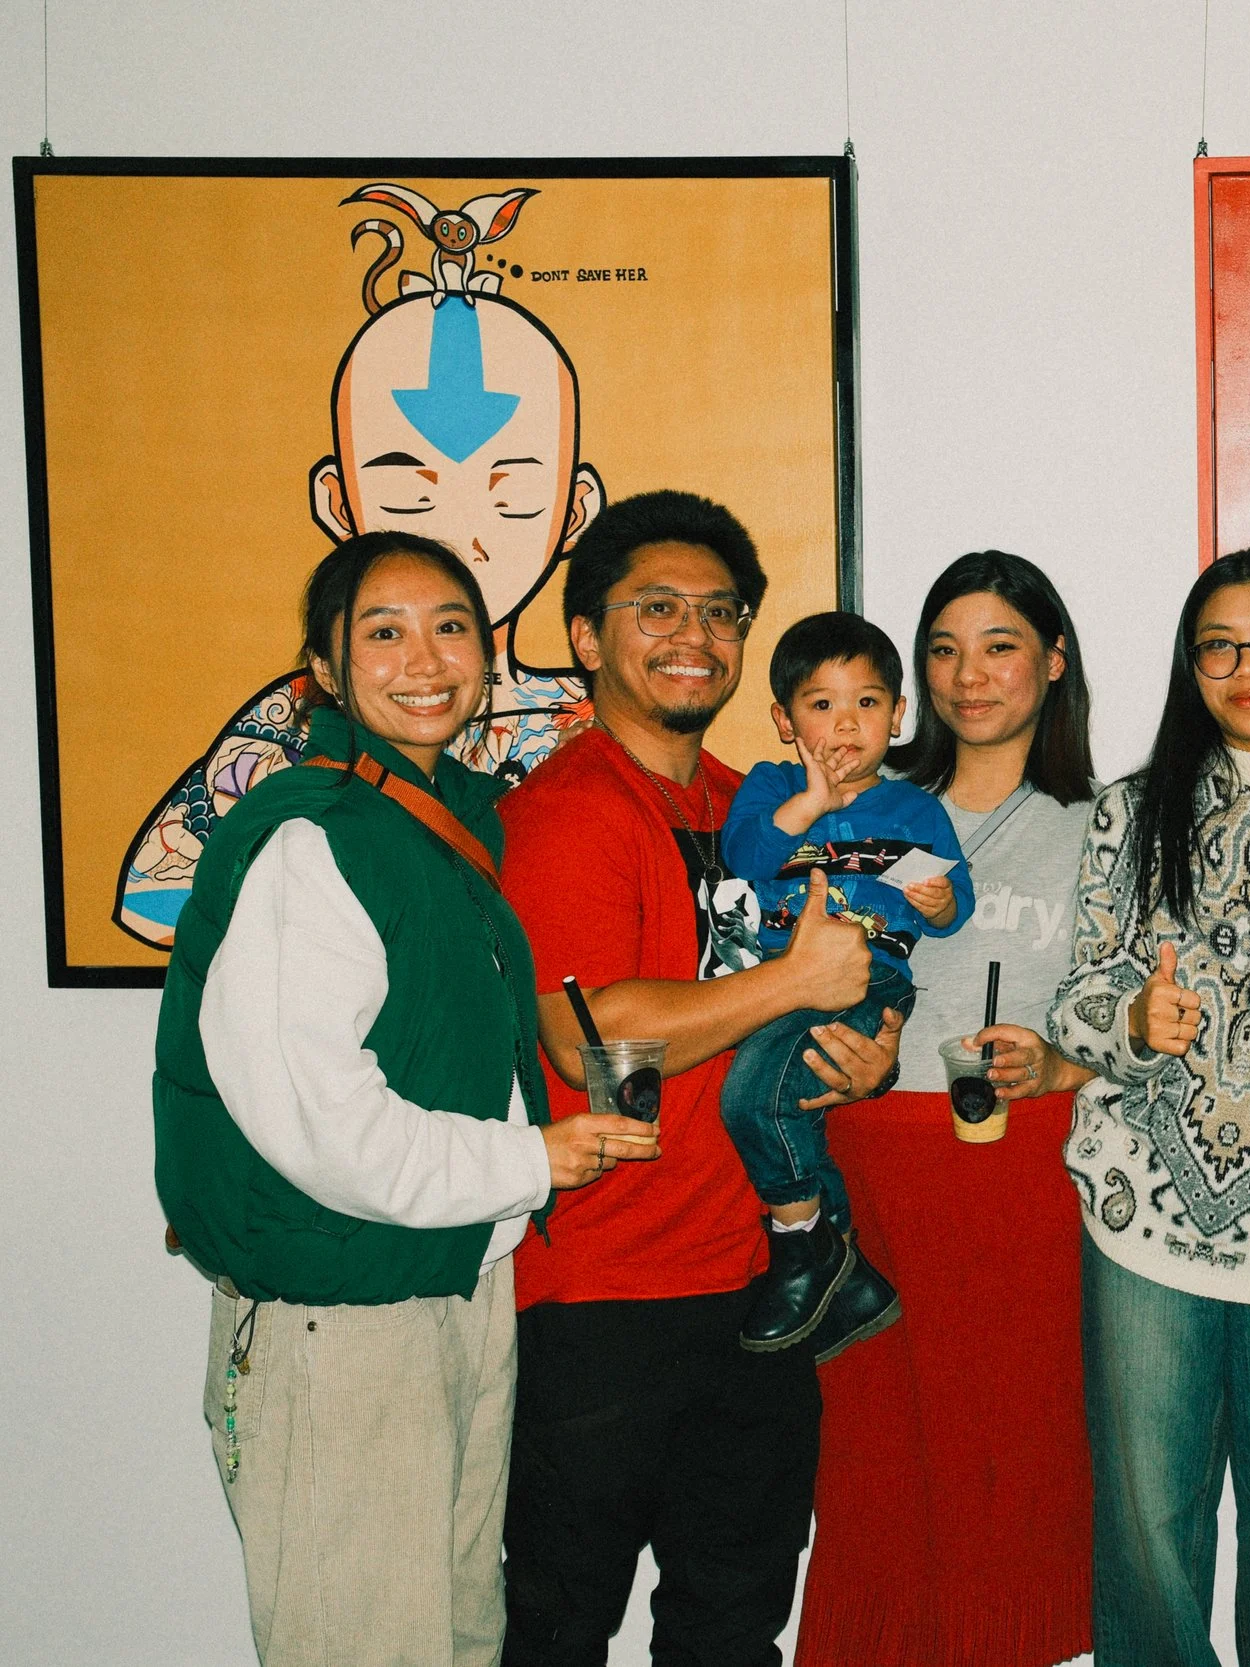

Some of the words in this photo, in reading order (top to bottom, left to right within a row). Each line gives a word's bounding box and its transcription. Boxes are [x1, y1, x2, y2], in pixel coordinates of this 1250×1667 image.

[531, 269, 569, 282] DONT
[576, 268, 611, 282] SAVE
[616, 267, 648, 281] HER
